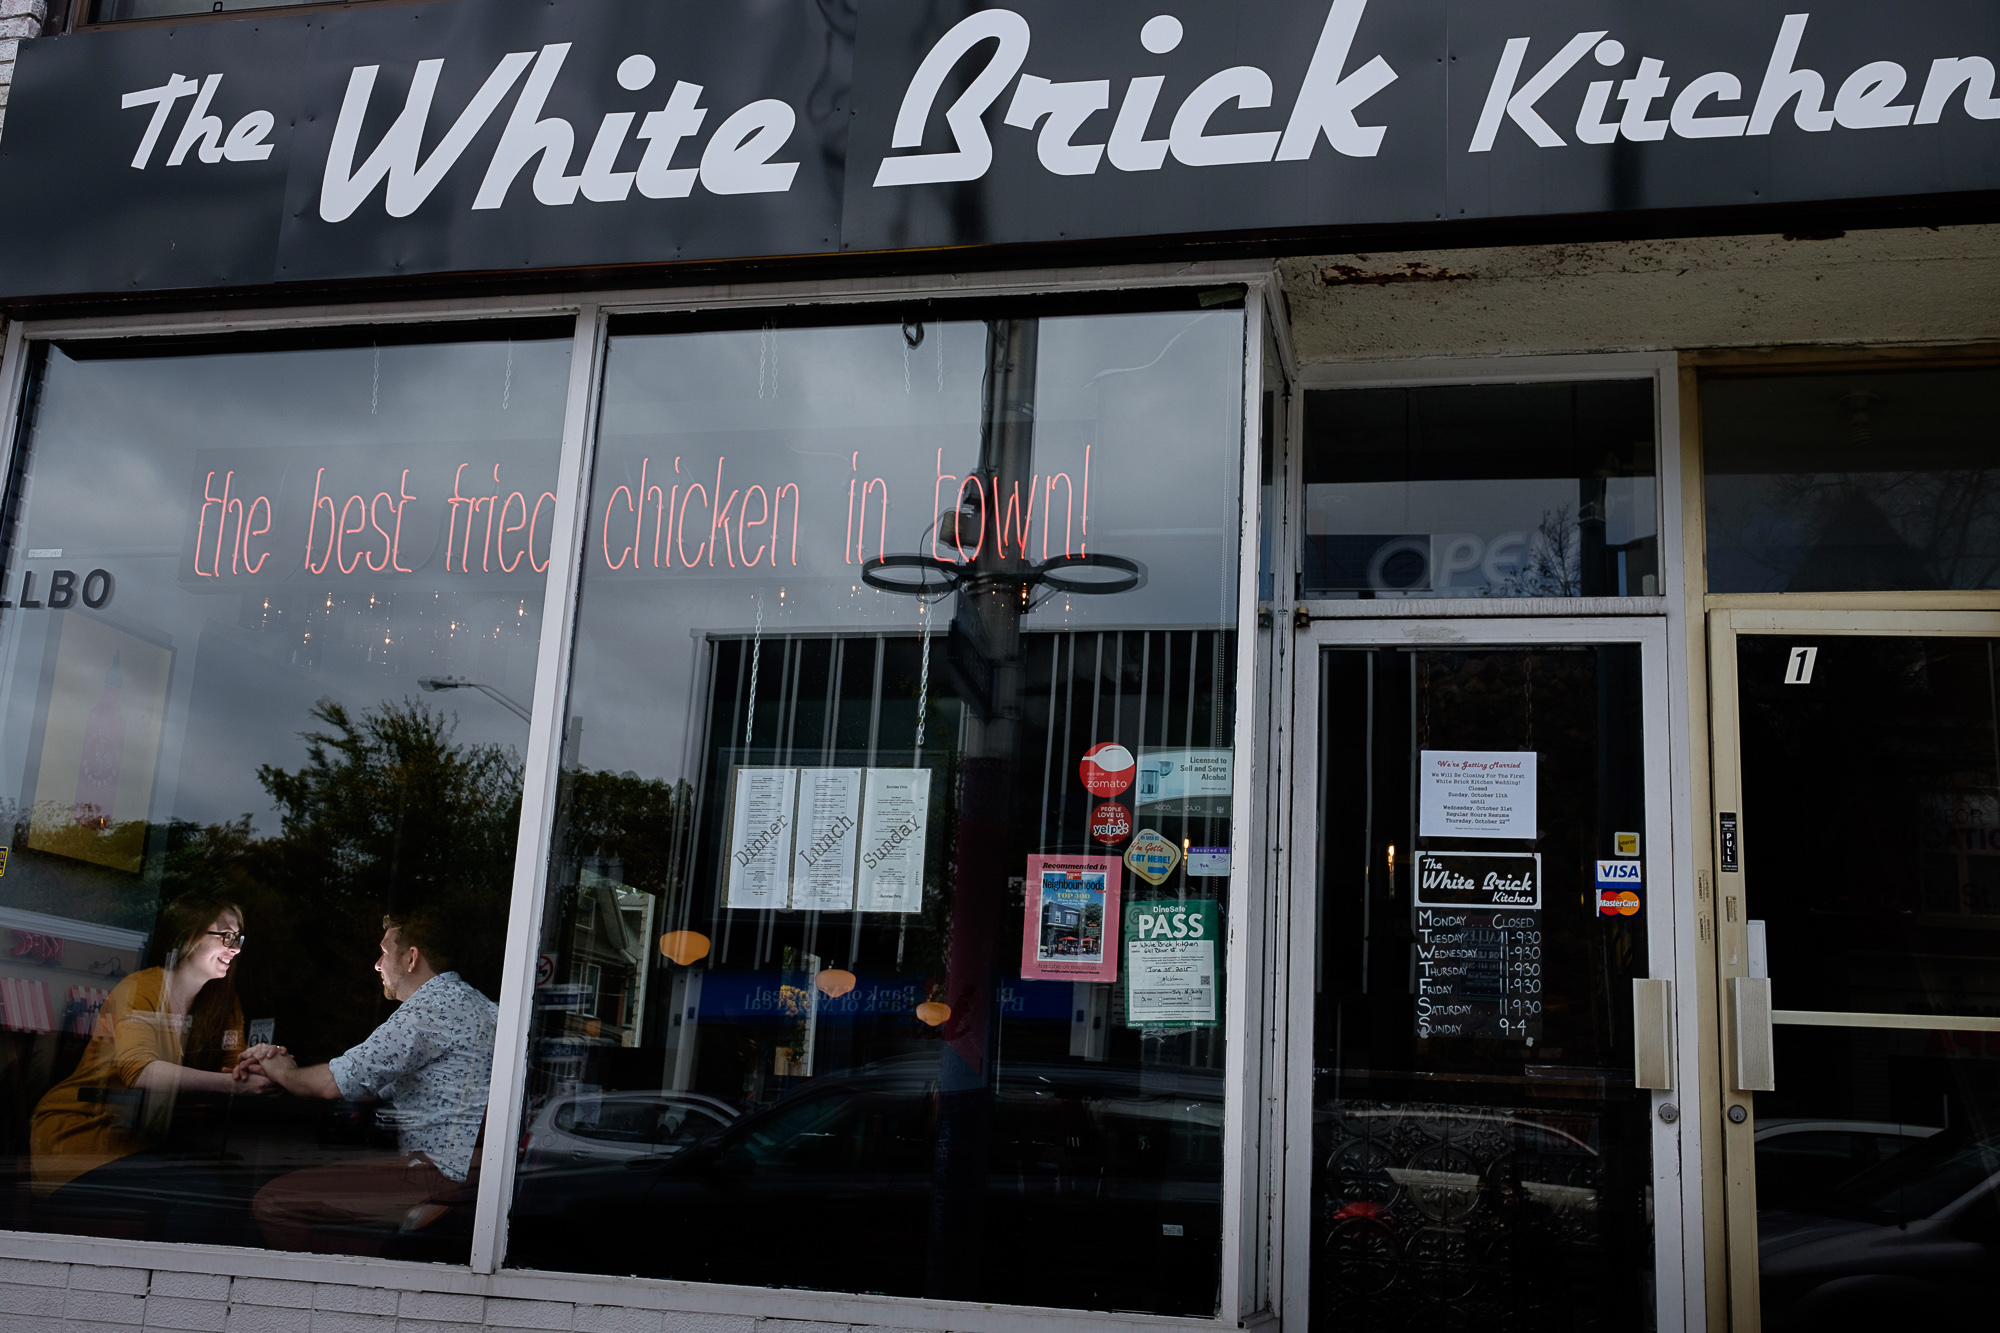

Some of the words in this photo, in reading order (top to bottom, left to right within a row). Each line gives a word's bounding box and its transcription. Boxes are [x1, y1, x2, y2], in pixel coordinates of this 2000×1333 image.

[121, 72, 275, 170] The
[319, 42, 800, 223] White
[872, 0, 1399, 188] Brick
[1468, 13, 2000, 152] Kitchen
[194, 470, 271, 577] the
[304, 467, 417, 574] best
[603, 456, 800, 569] chicken
[846, 451, 888, 565] in
[1793, 648, 1811, 682] 1
[1189, 756, 1218, 764] Licensed
[1437, 760, 1460, 768] We're
[1461, 760, 1488, 771] Getting
[1489, 761, 1522, 770] Married
[1208, 765, 1227, 773] Serve
[1086, 780, 1128, 789] zomato
[1093, 823, 1117, 836] yelp
[733, 814, 789, 868] Dinner
[798, 815, 855, 867] Lunch
[862, 814, 921, 870] Sunday
[1131, 841, 1143, 851] You
[1144, 842, 1164, 853] Gotta
[1130, 853, 1146, 862] EAT
[1147, 854, 1171, 864] HERE!
[1422, 858, 1443, 870] The
[1042, 862, 1098, 870] Recommended
[1099, 862, 1108, 870] in
[1600, 865, 1639, 878] VISA
[1042, 878, 1105, 891] Neighbourhoods
[1421, 870, 1475, 890] White
[1481, 871, 1533, 891] Brick
[1491, 891, 1534, 903] Kitchen
[1153, 905, 1186, 913] DineSafe
[1599, 899, 1639, 908] MasterCard
[1138, 913, 1204, 939] PASS
